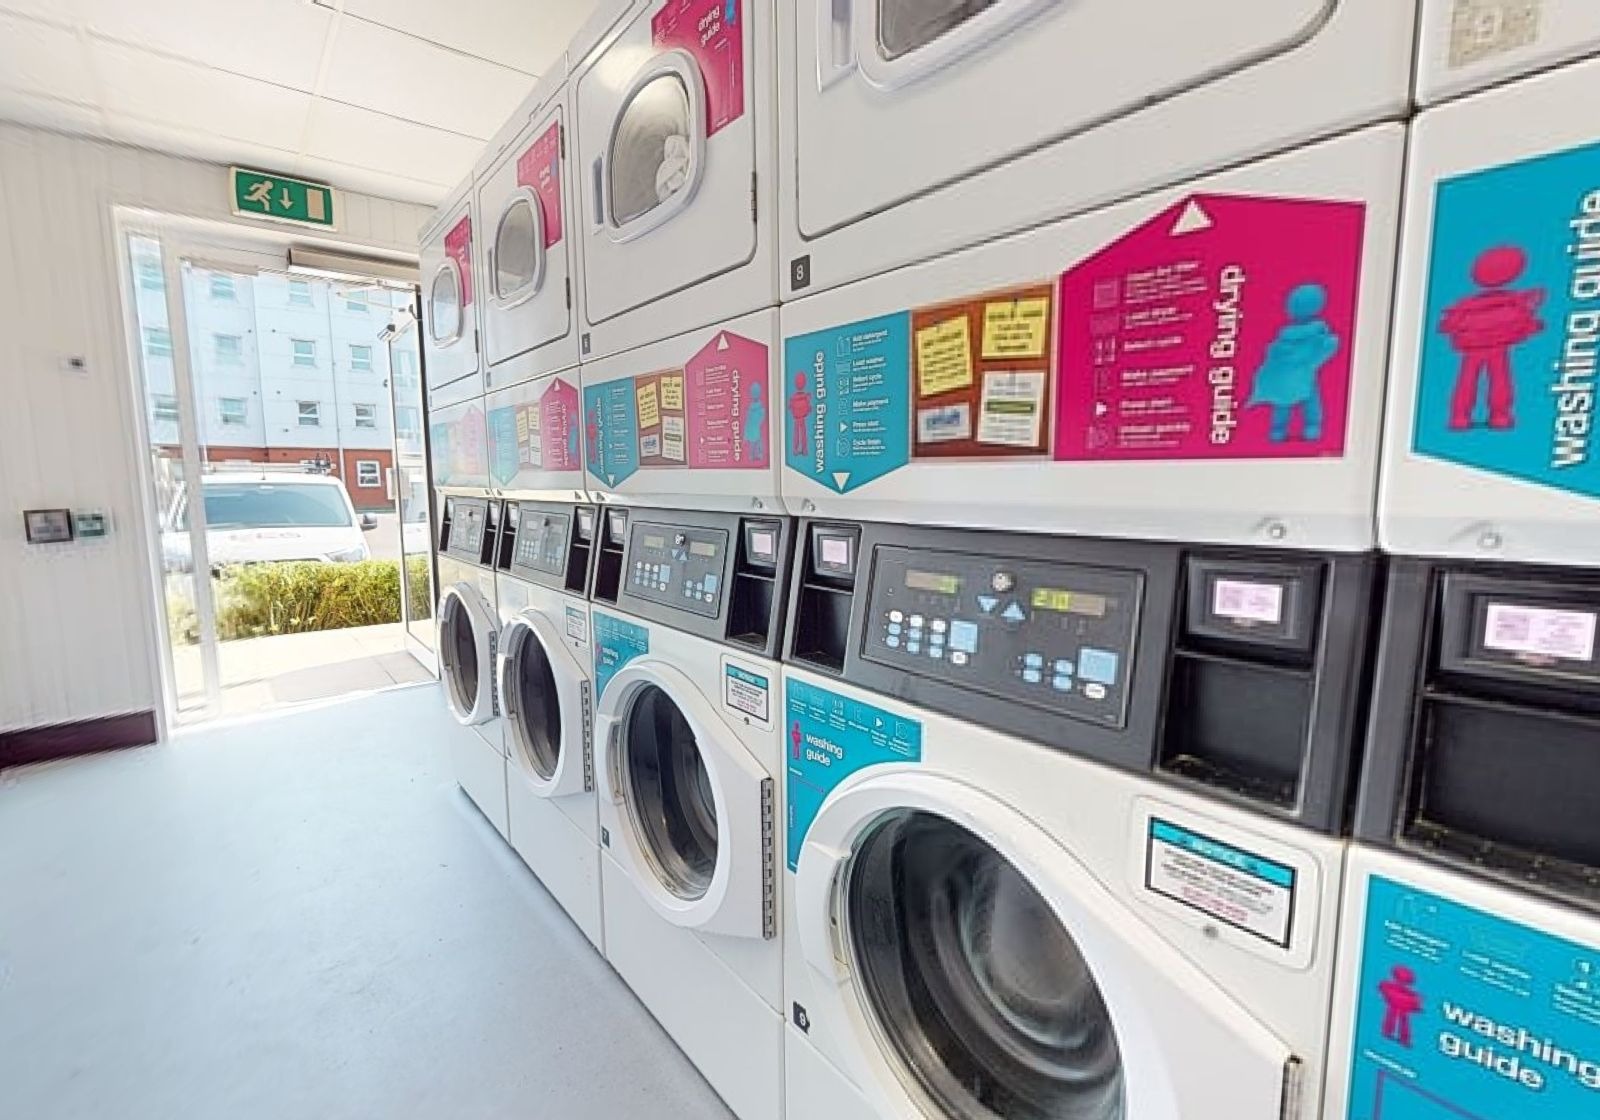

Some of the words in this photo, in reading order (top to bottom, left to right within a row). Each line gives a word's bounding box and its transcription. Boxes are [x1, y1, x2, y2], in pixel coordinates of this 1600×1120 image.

[796, 264, 804, 281] 8
[1210, 264, 1246, 358] drying
[731, 369, 742, 417] drying
[814, 351, 827, 398] guide
[1551, 308, 1600, 467] washing
[1208, 366, 1239, 444] guide
[731, 420, 743, 462] guide
[814, 402, 827, 474] washing
[805, 732, 843, 760] washing
[806, 748, 831, 767] guide
[1438, 1031, 1545, 1090] guide
[1442, 1001, 1600, 1089] washing
